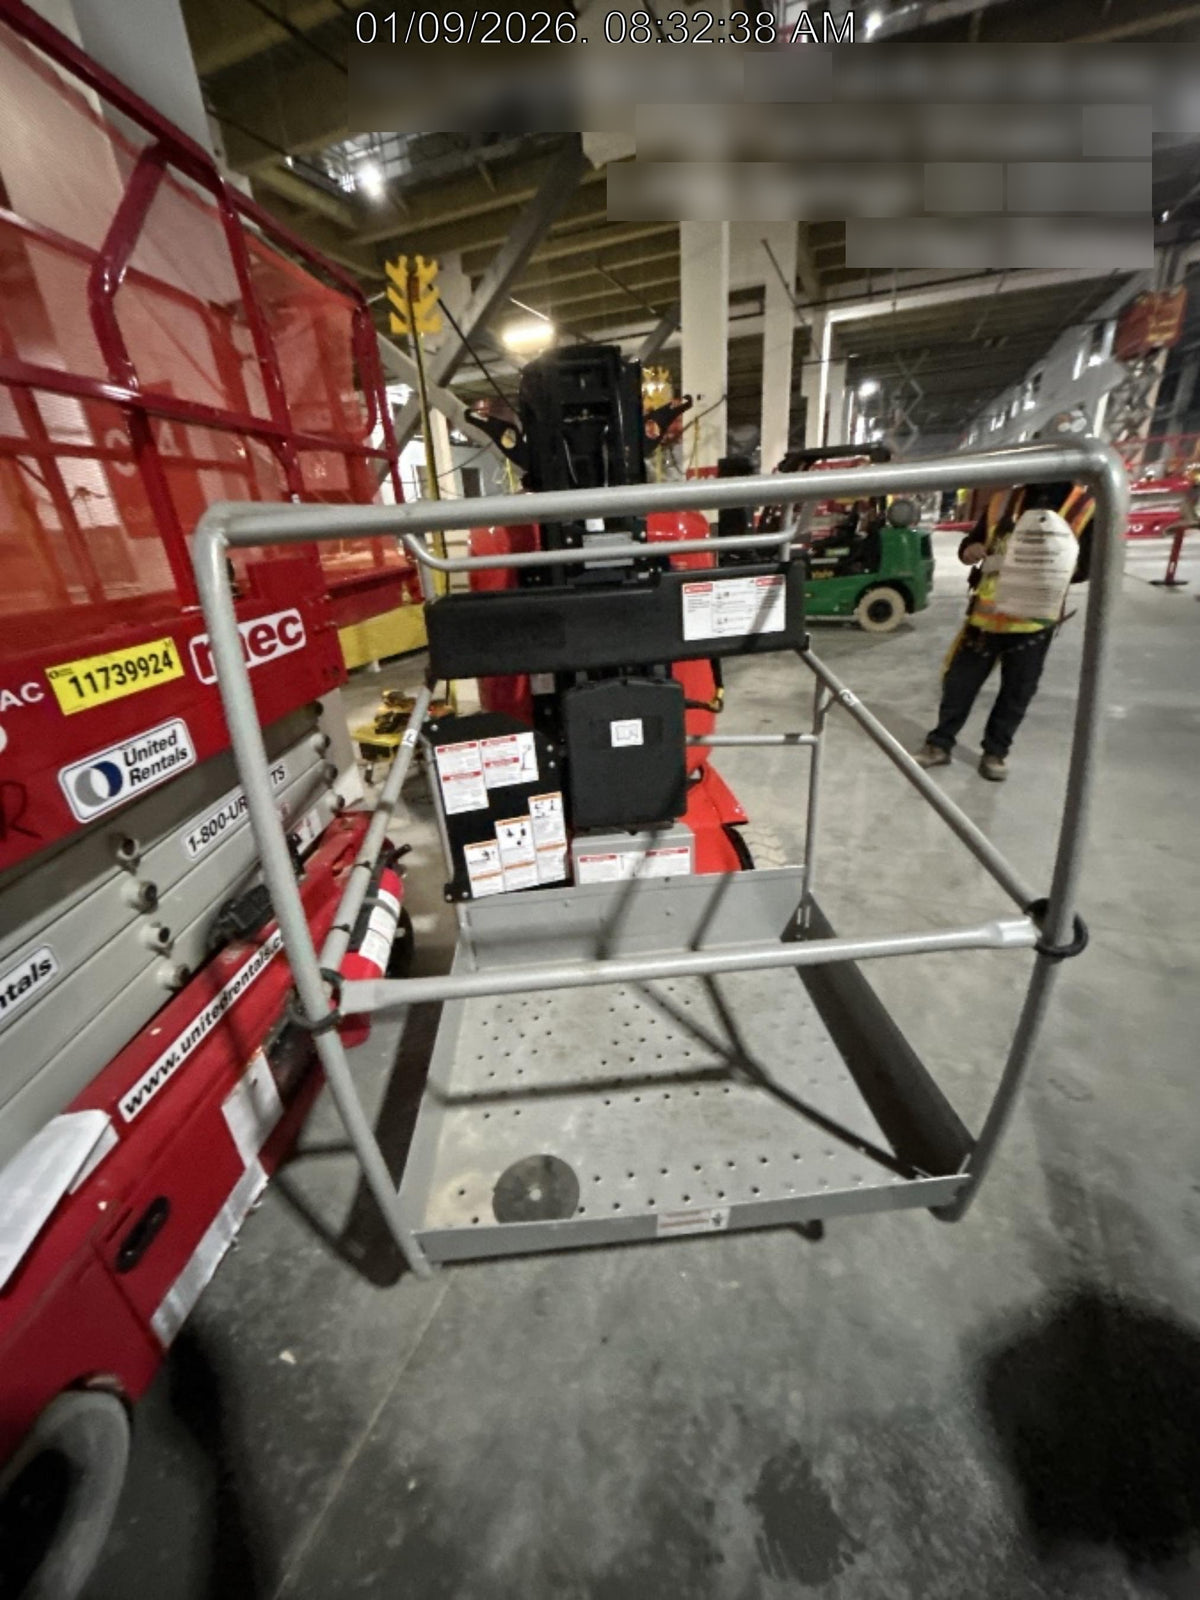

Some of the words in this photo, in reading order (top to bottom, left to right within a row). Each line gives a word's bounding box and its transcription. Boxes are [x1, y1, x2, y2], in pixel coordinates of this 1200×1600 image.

[68, 650, 174, 698] 11739924
[123, 728, 178, 768] United
[129, 747, 188, 787] Rentals
[125, 936, 284, 1114] www.unitedrentals.c
